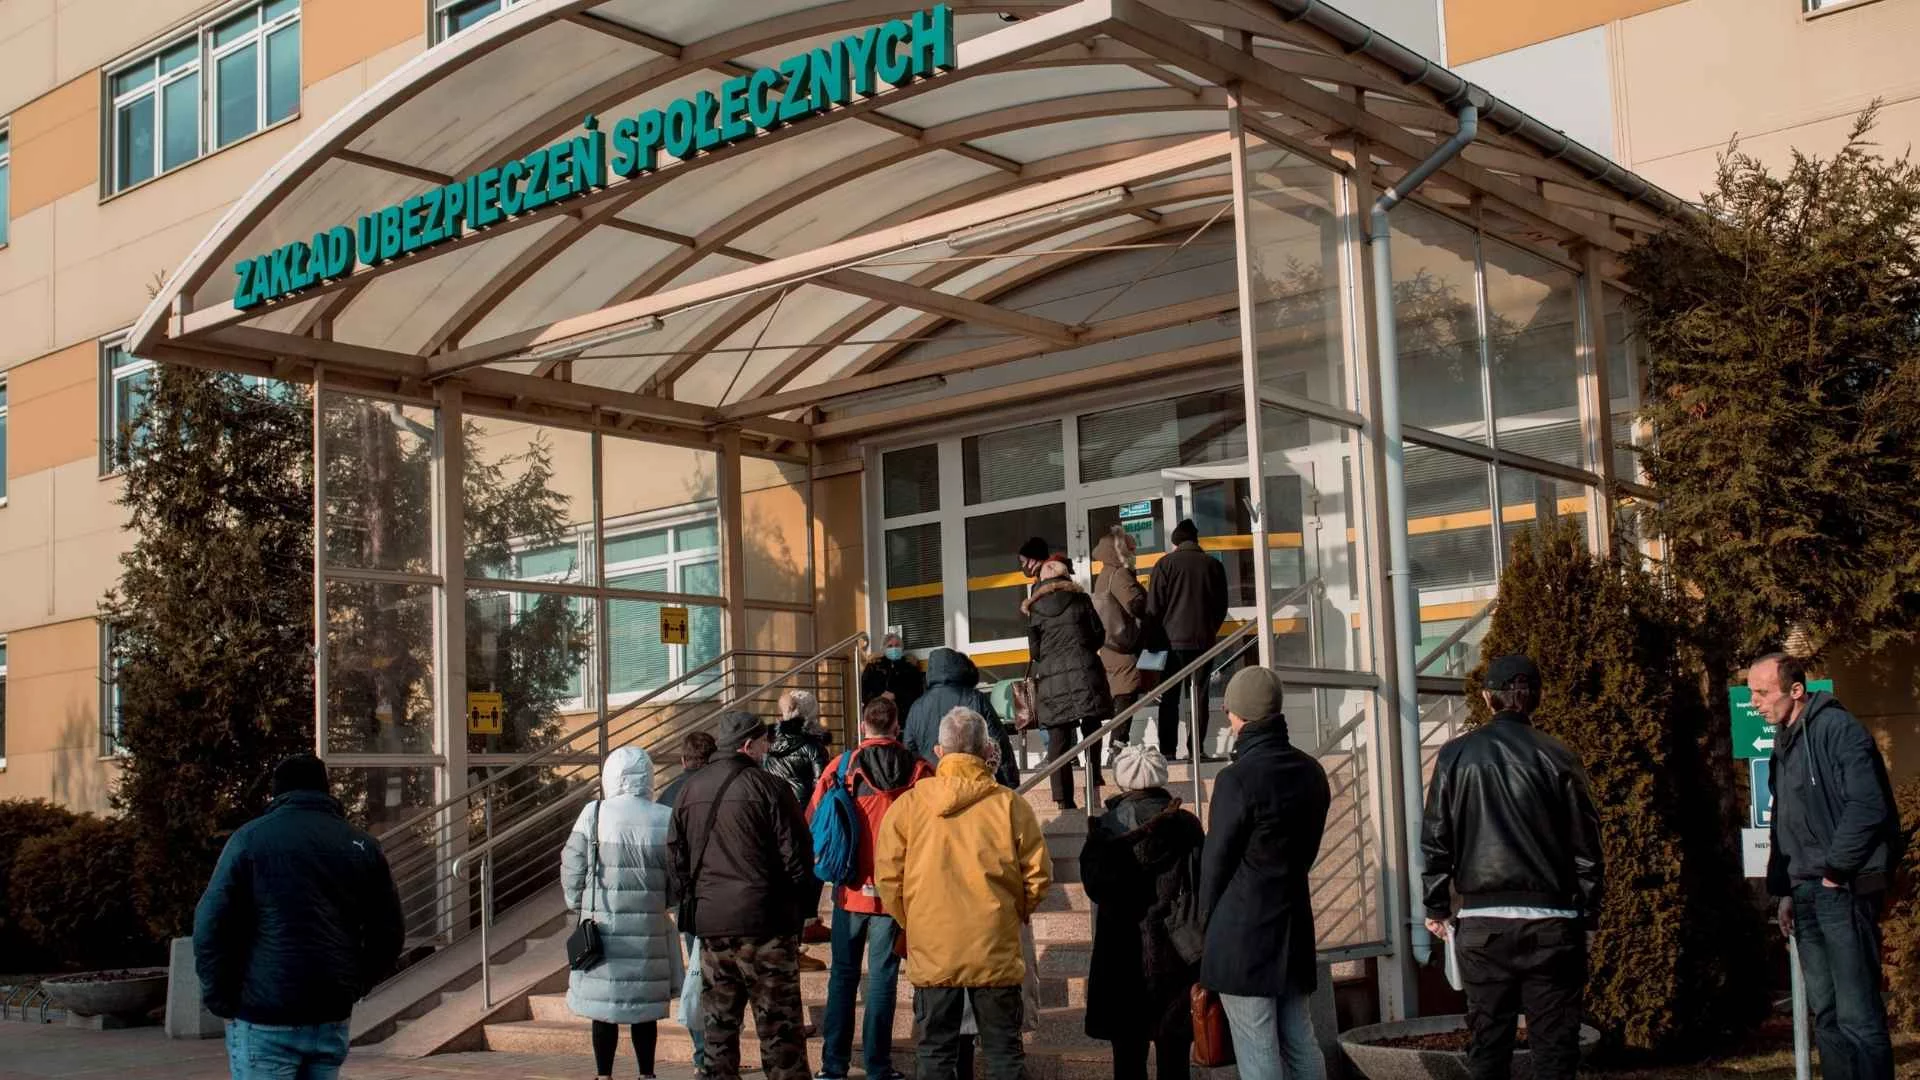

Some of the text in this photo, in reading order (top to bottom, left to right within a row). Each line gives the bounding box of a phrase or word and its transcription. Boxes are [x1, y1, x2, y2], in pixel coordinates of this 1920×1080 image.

[233, 3, 954, 311] ZAKŁAD UBEZPIECZEŃ SPOŁECZNYCH
